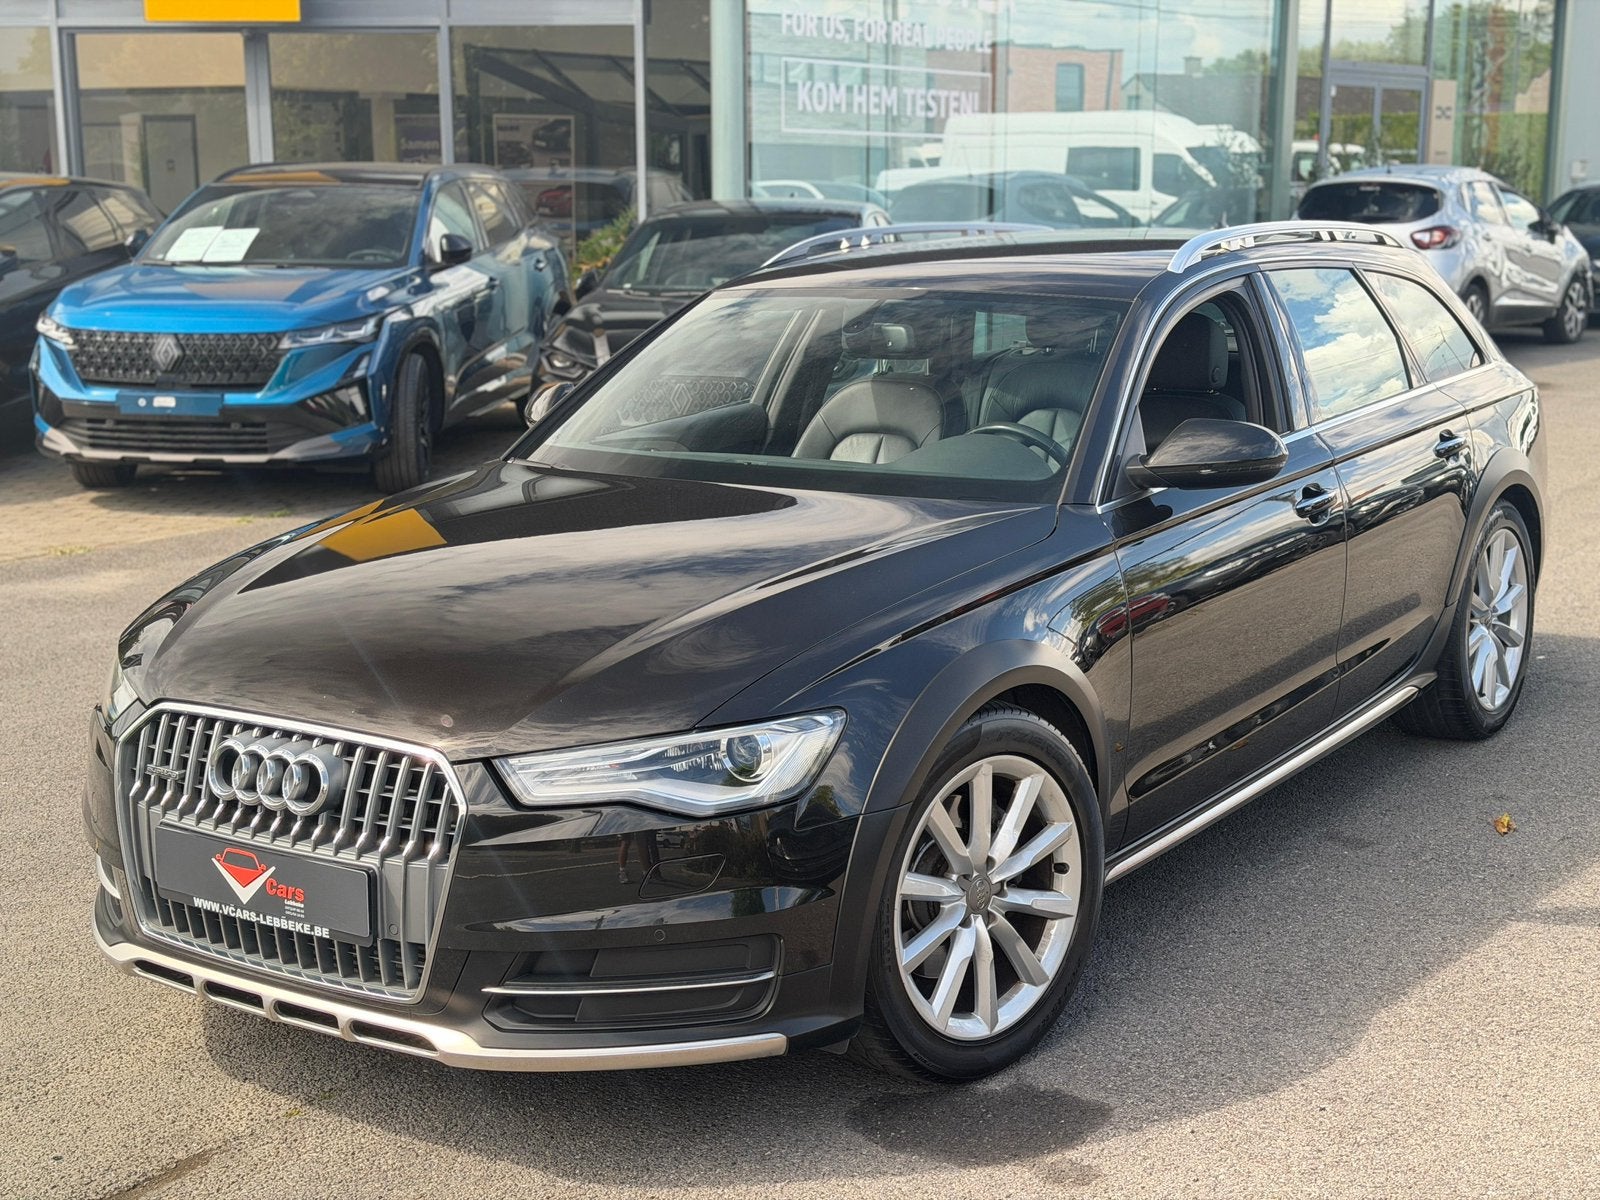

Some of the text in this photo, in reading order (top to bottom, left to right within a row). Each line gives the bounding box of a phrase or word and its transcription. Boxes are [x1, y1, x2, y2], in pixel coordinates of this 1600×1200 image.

[782, 11, 993, 54] FOR US, FOR REAL PEOPLE
[798, 81, 979, 118] KOM HEM TESTEN!
[266, 877, 305, 901] Cars
[193, 896, 330, 938] WWW.VCARS-LEBBEKE.BE
